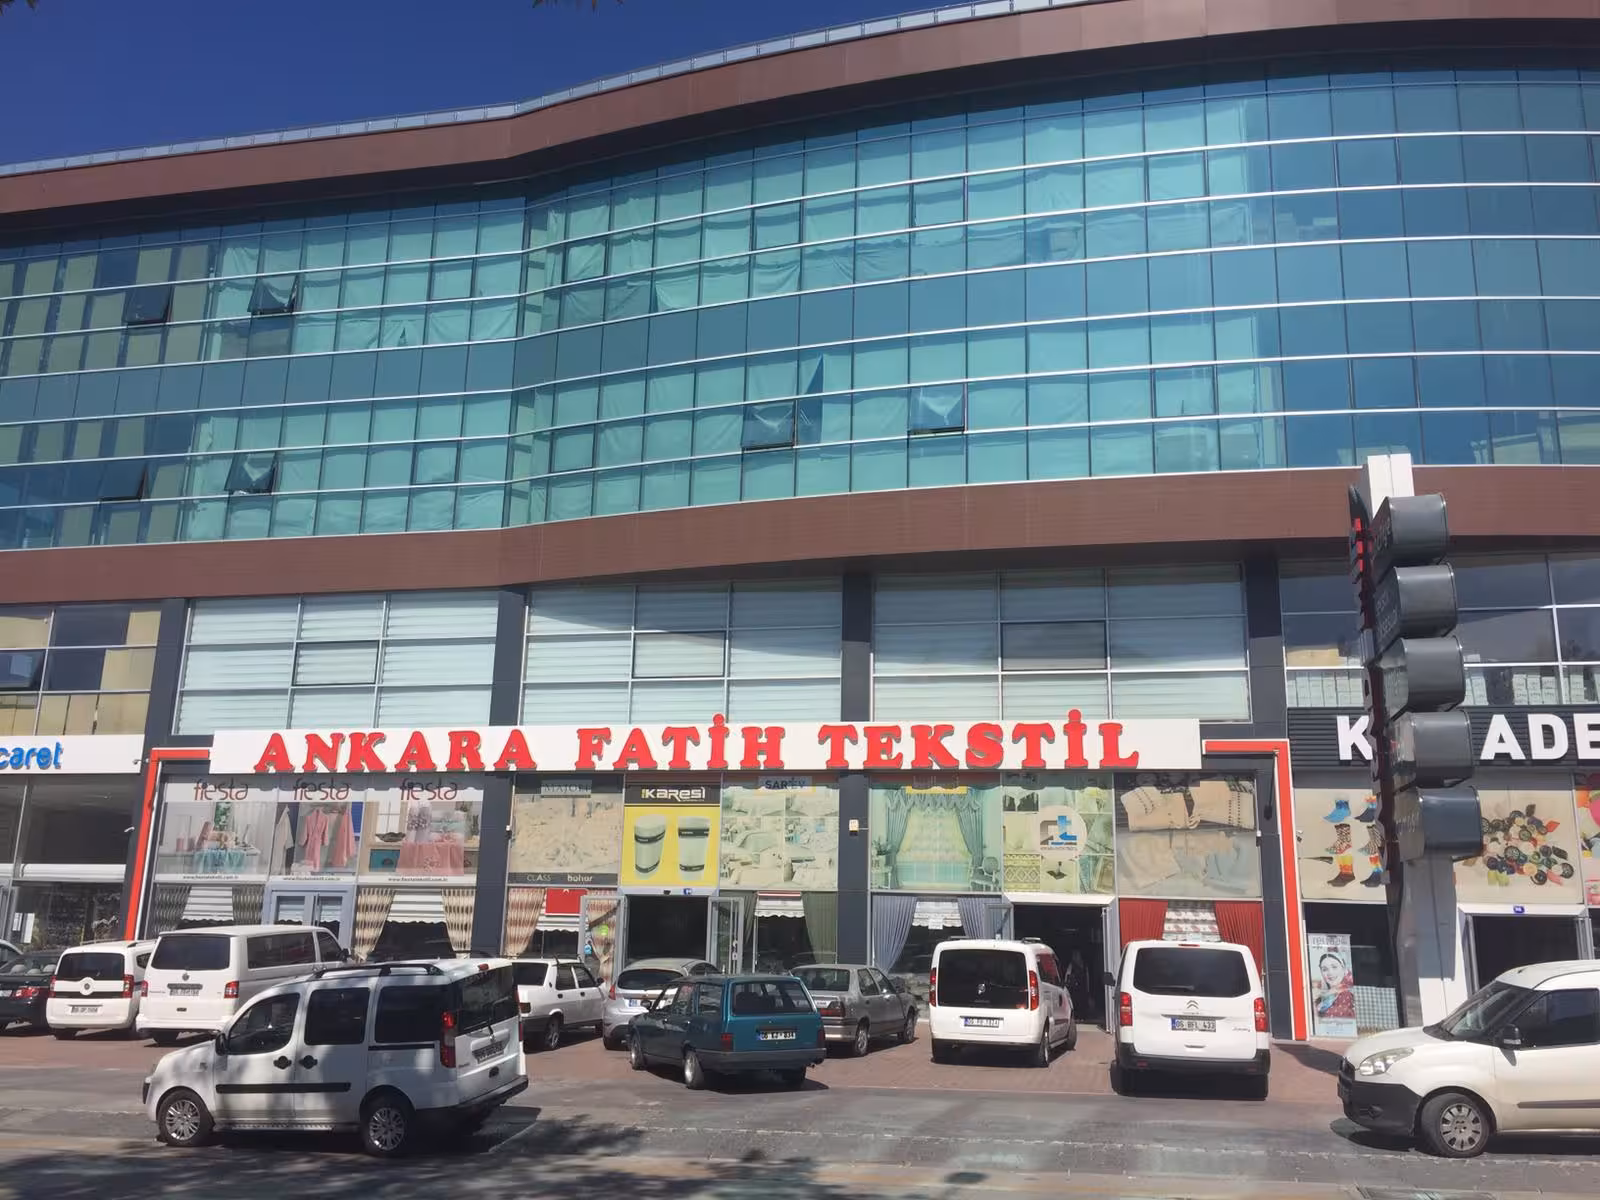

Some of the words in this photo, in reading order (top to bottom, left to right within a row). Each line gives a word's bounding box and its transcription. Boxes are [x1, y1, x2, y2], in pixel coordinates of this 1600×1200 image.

[254, 729, 536, 772] ANKARA
[575, 713, 786, 771] FATİH
[817, 709, 1140, 769] TEKSTİL
[194, 777, 249, 800] fiesta
[293, 777, 350, 800] fiesta
[400, 777, 458, 800] fiesta
